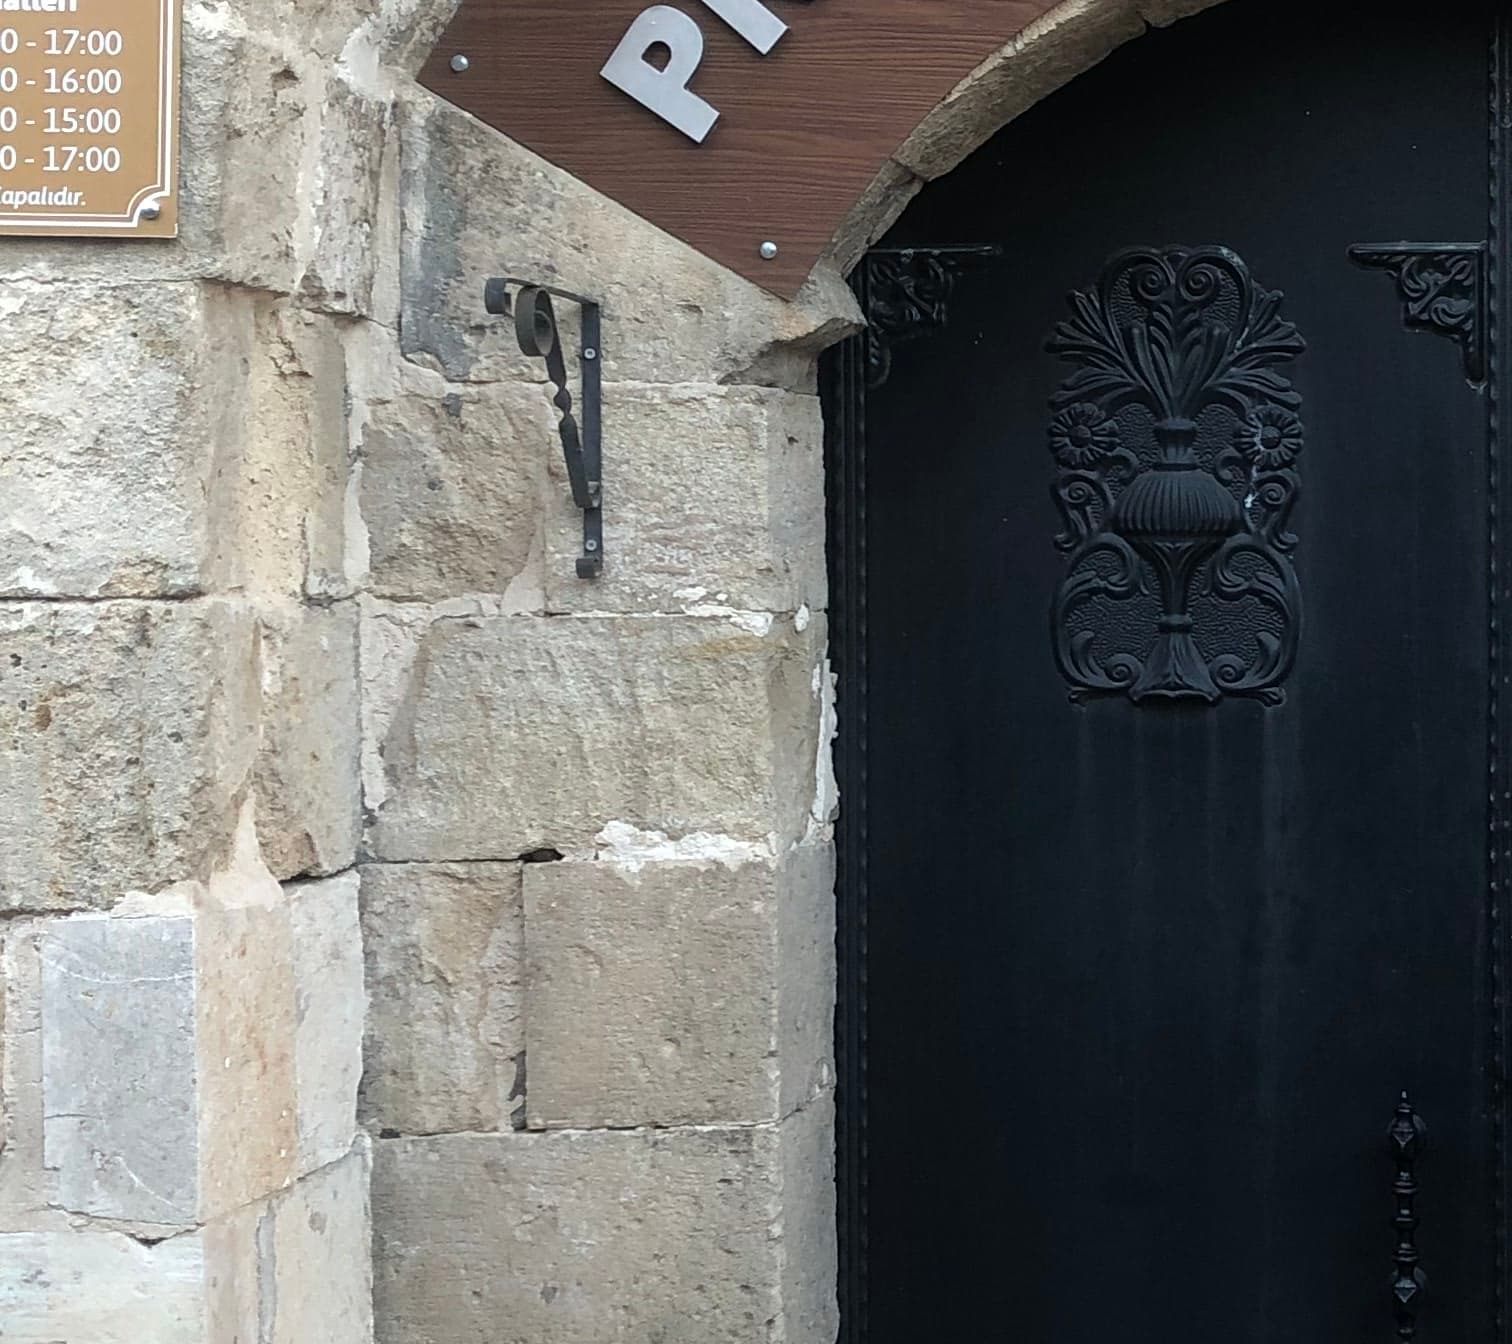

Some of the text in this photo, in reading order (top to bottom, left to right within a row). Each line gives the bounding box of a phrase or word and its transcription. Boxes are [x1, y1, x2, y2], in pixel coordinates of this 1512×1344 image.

[44, 29, 122, 56] 17:00
[44, 68, 122, 94] 16:00
[43, 108, 121, 133] 15:00
[42, 146, 121, 172] 17:00
